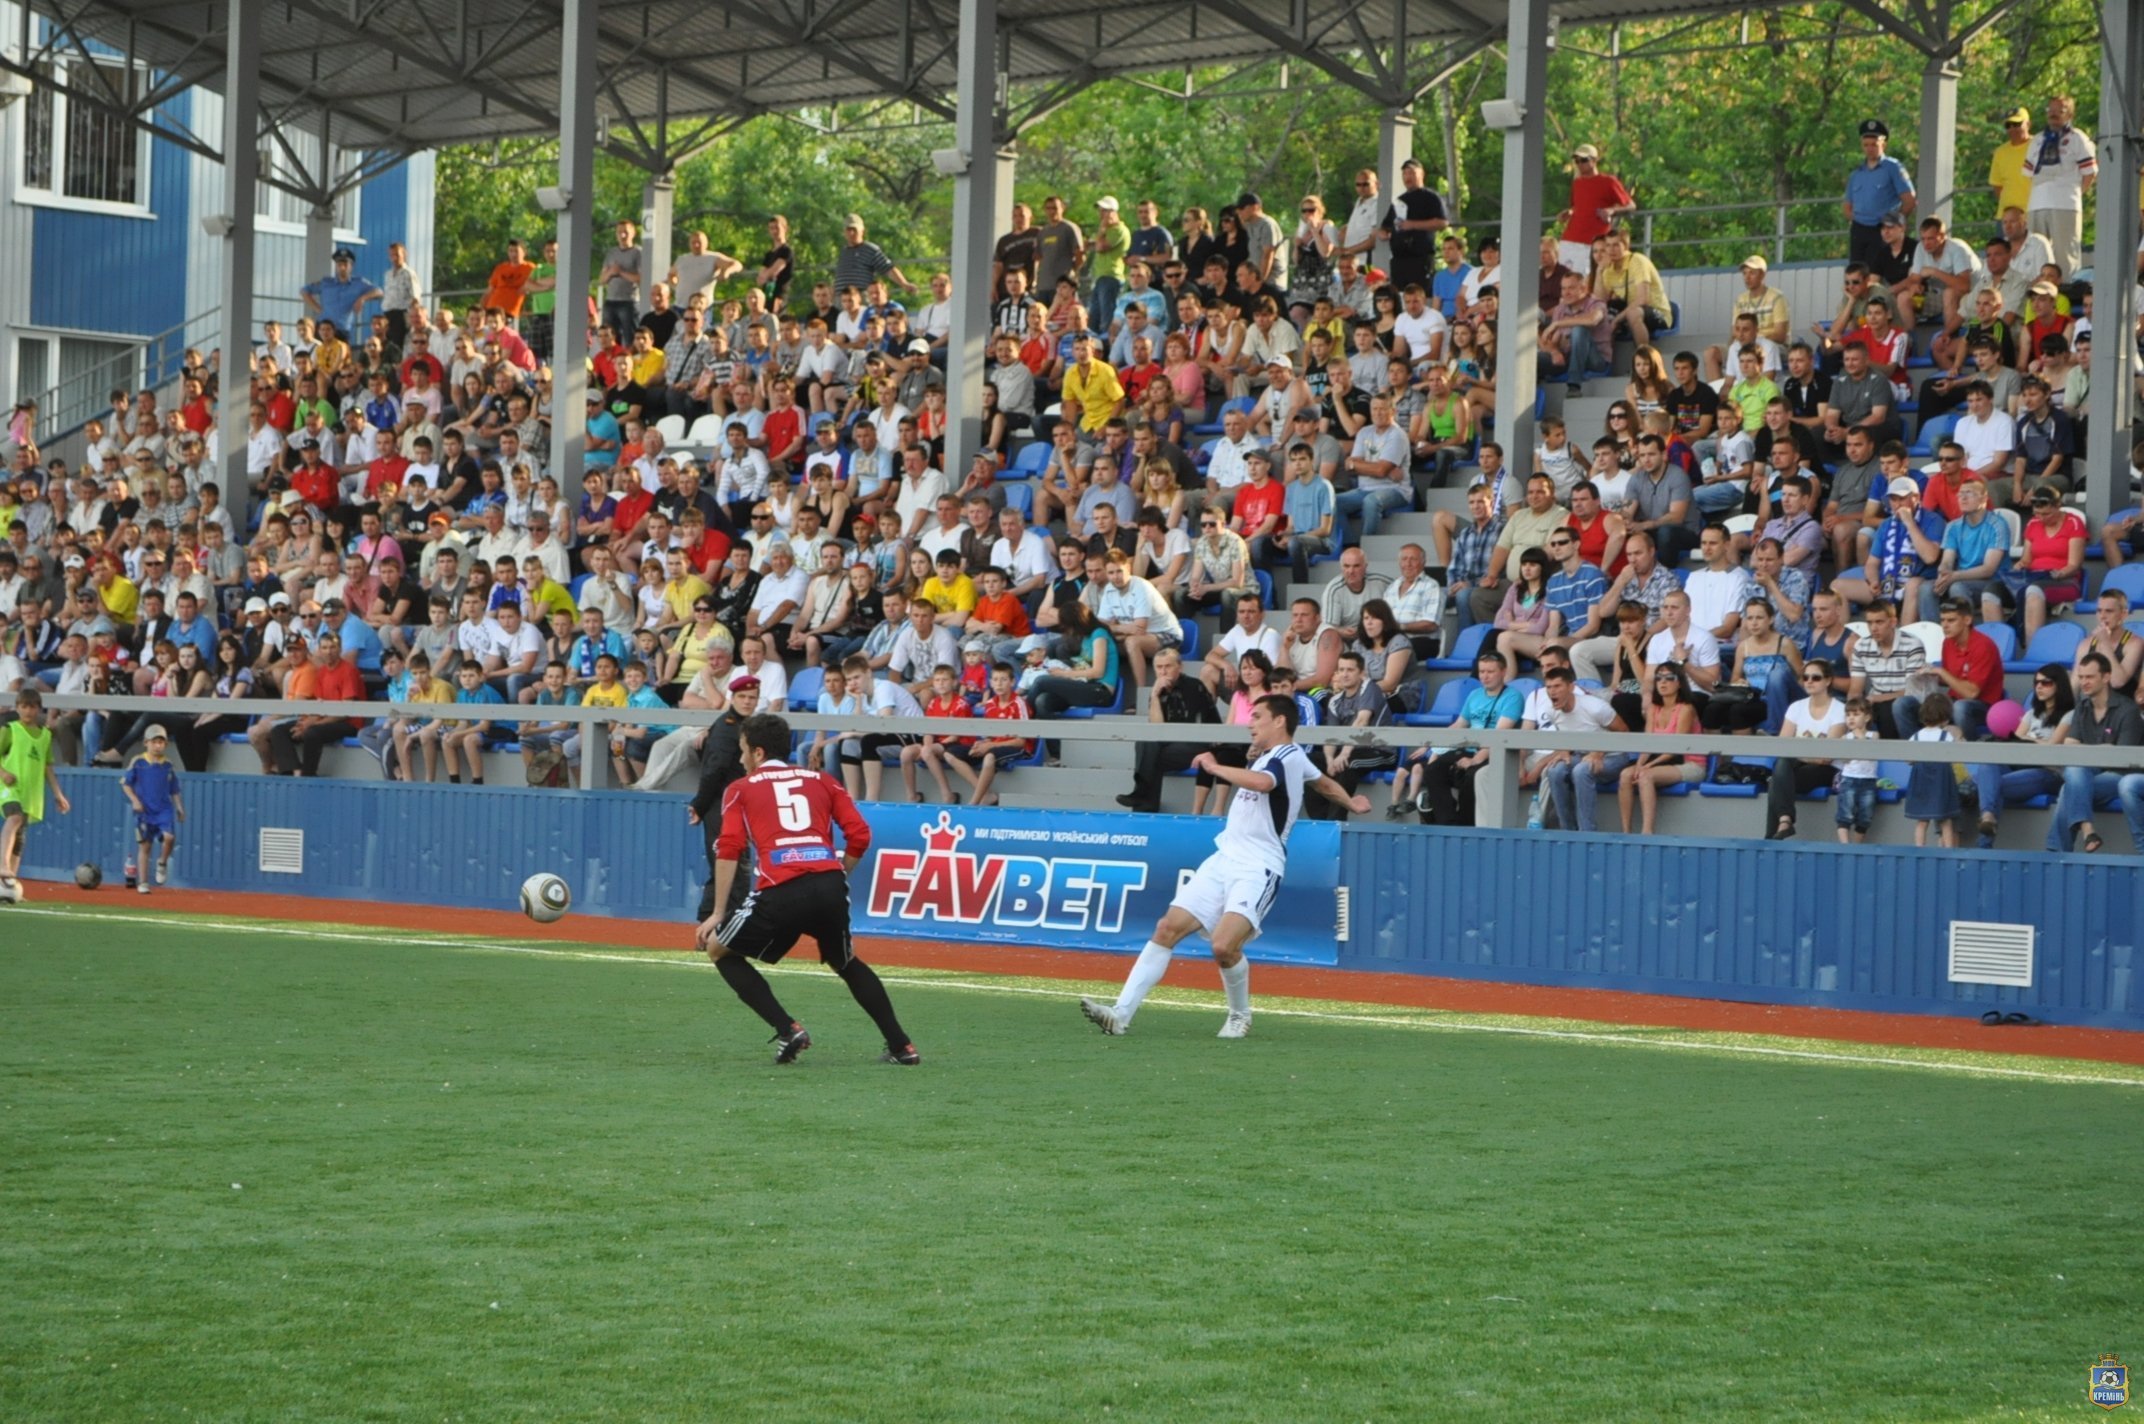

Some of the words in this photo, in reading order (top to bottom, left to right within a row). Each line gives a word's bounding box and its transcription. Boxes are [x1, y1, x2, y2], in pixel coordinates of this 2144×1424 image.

[772, 778, 812, 832] 5
[974, 828, 988, 839] МИ
[867, 849, 1148, 932] FAVBET
